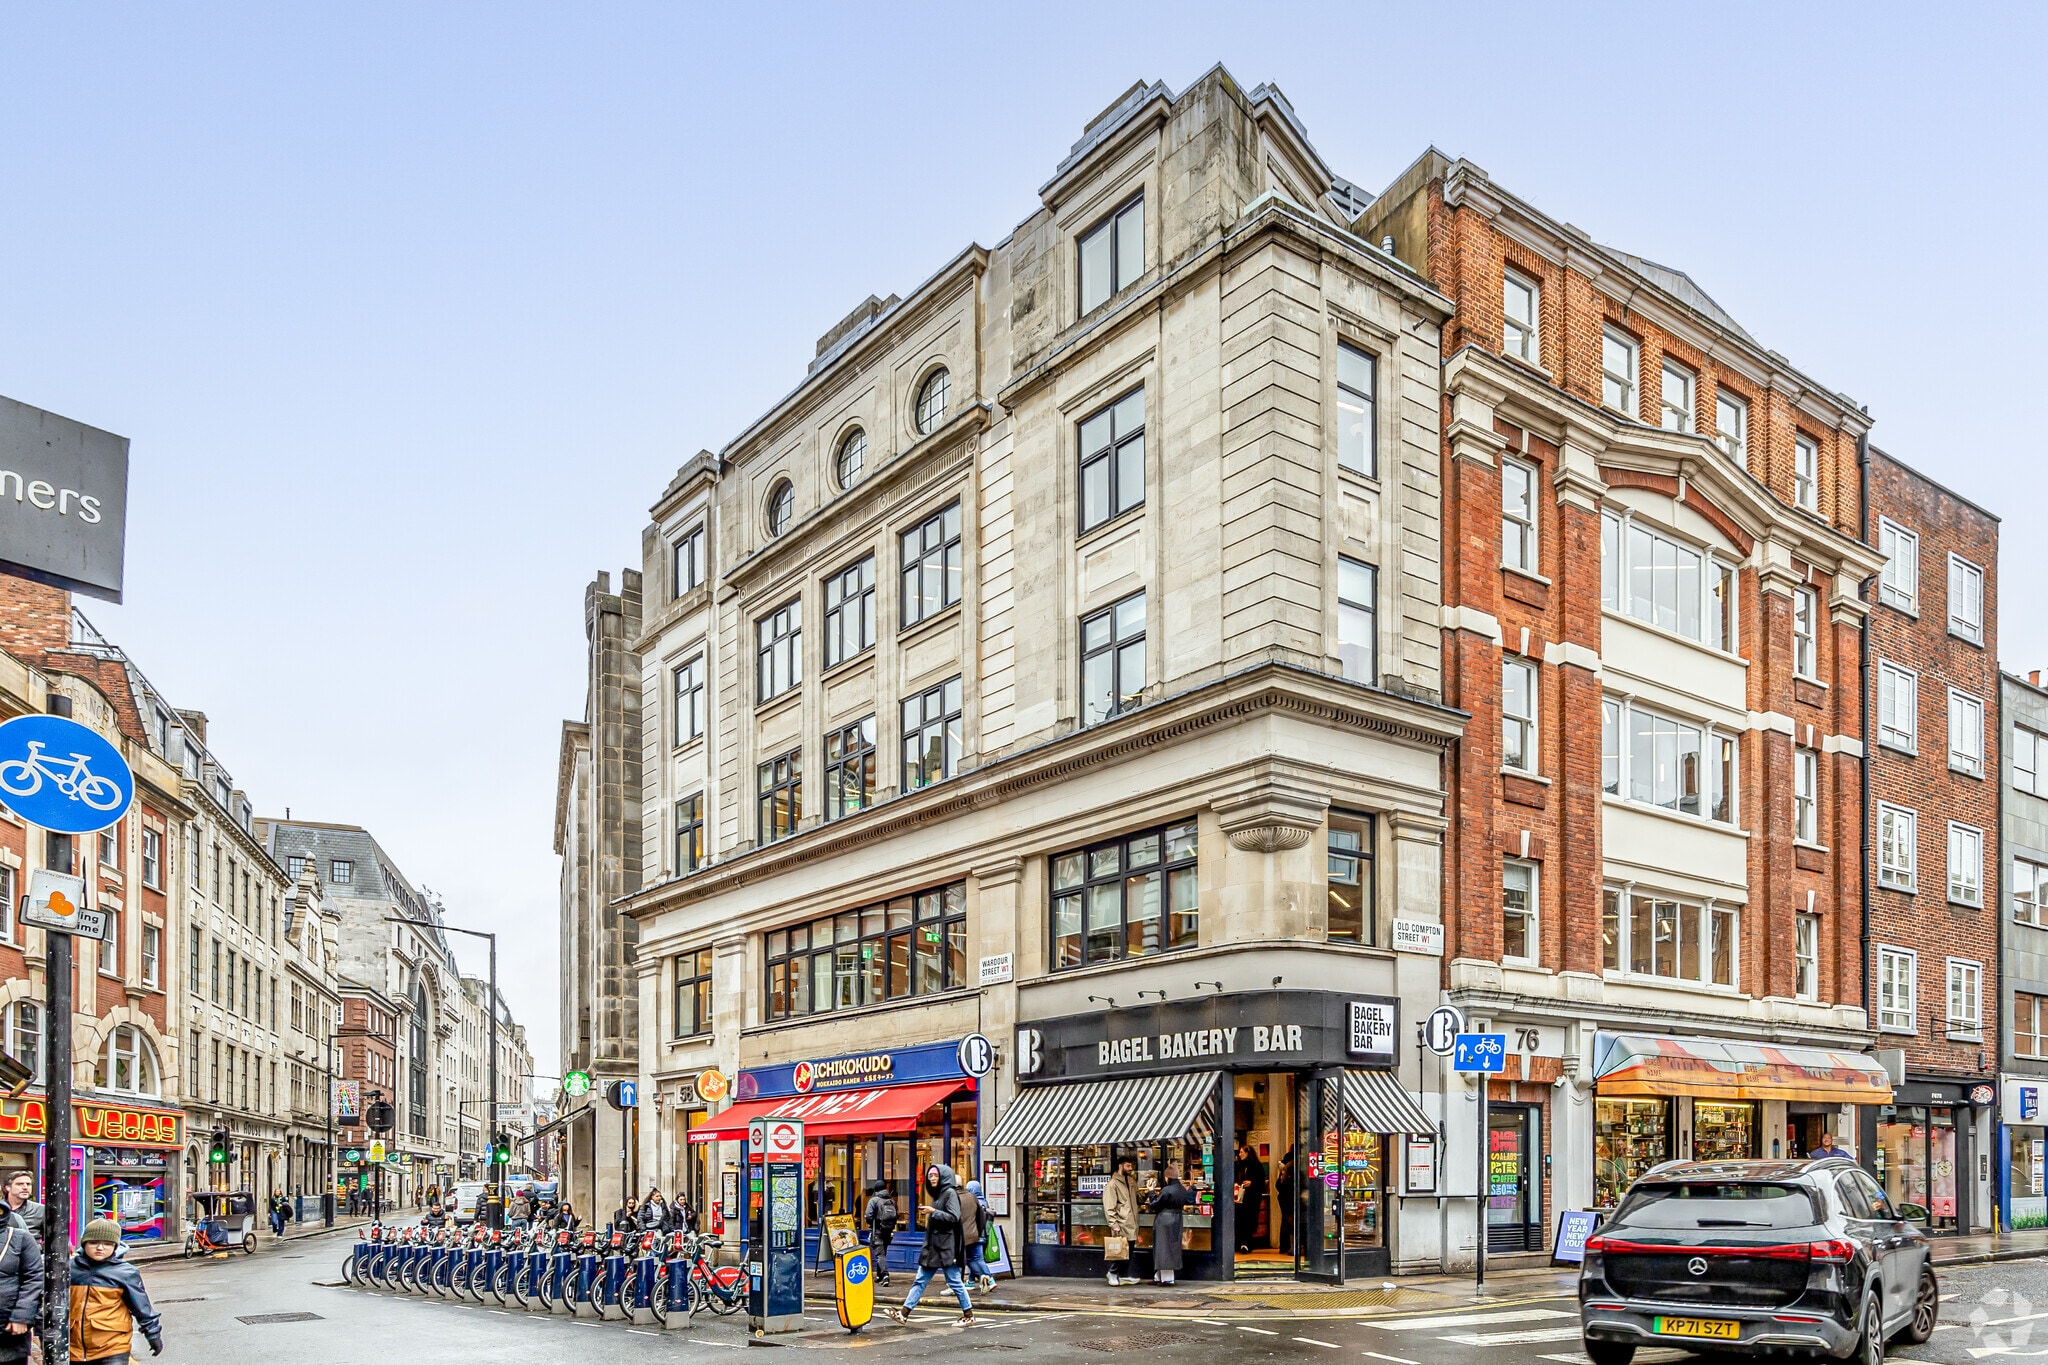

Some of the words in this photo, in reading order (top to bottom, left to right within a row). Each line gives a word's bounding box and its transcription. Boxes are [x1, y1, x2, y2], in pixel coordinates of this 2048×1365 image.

[1398, 922, 1409, 931] OLD
[1412, 924, 1440, 935] COMPTON
[1398, 932, 1419, 942] STREET
[1421, 935, 1430, 944] W1
[982, 956, 1008, 968] WARDOUR
[982, 967, 999, 977] STREET
[1354, 1006, 1384, 1022] BAGEL
[1354, 1020, 1392, 1037] BAKERY
[1354, 1035, 1373, 1050] BAR
[1515, 1027, 1540, 1051] 76
[1099, 1036, 1153, 1066] BAGEL
[1159, 1027, 1237, 1060] BAKERY
[1253, 1025, 1302, 1052] BAR
[813, 1054, 891, 1079] ICHIKOKUDO
[843, 1077, 860, 1085] RAMEN
[0, 1098, 47, 1133] LA
[77, 1107, 176, 1143] VEGAS
[1082, 1175, 1096, 1184] FRESH
[1082, 1183, 1096, 1191] BAKED
[1570, 1217, 1588, 1226] NEW
[1567, 1225, 1588, 1233] YEAR
[1567, 1232, 1585, 1240] NEW
[1565, 1239, 1585, 1247] YOU?
[1666, 1319, 1699, 1333] KP71
[1704, 1322, 1734, 1335] SZT
